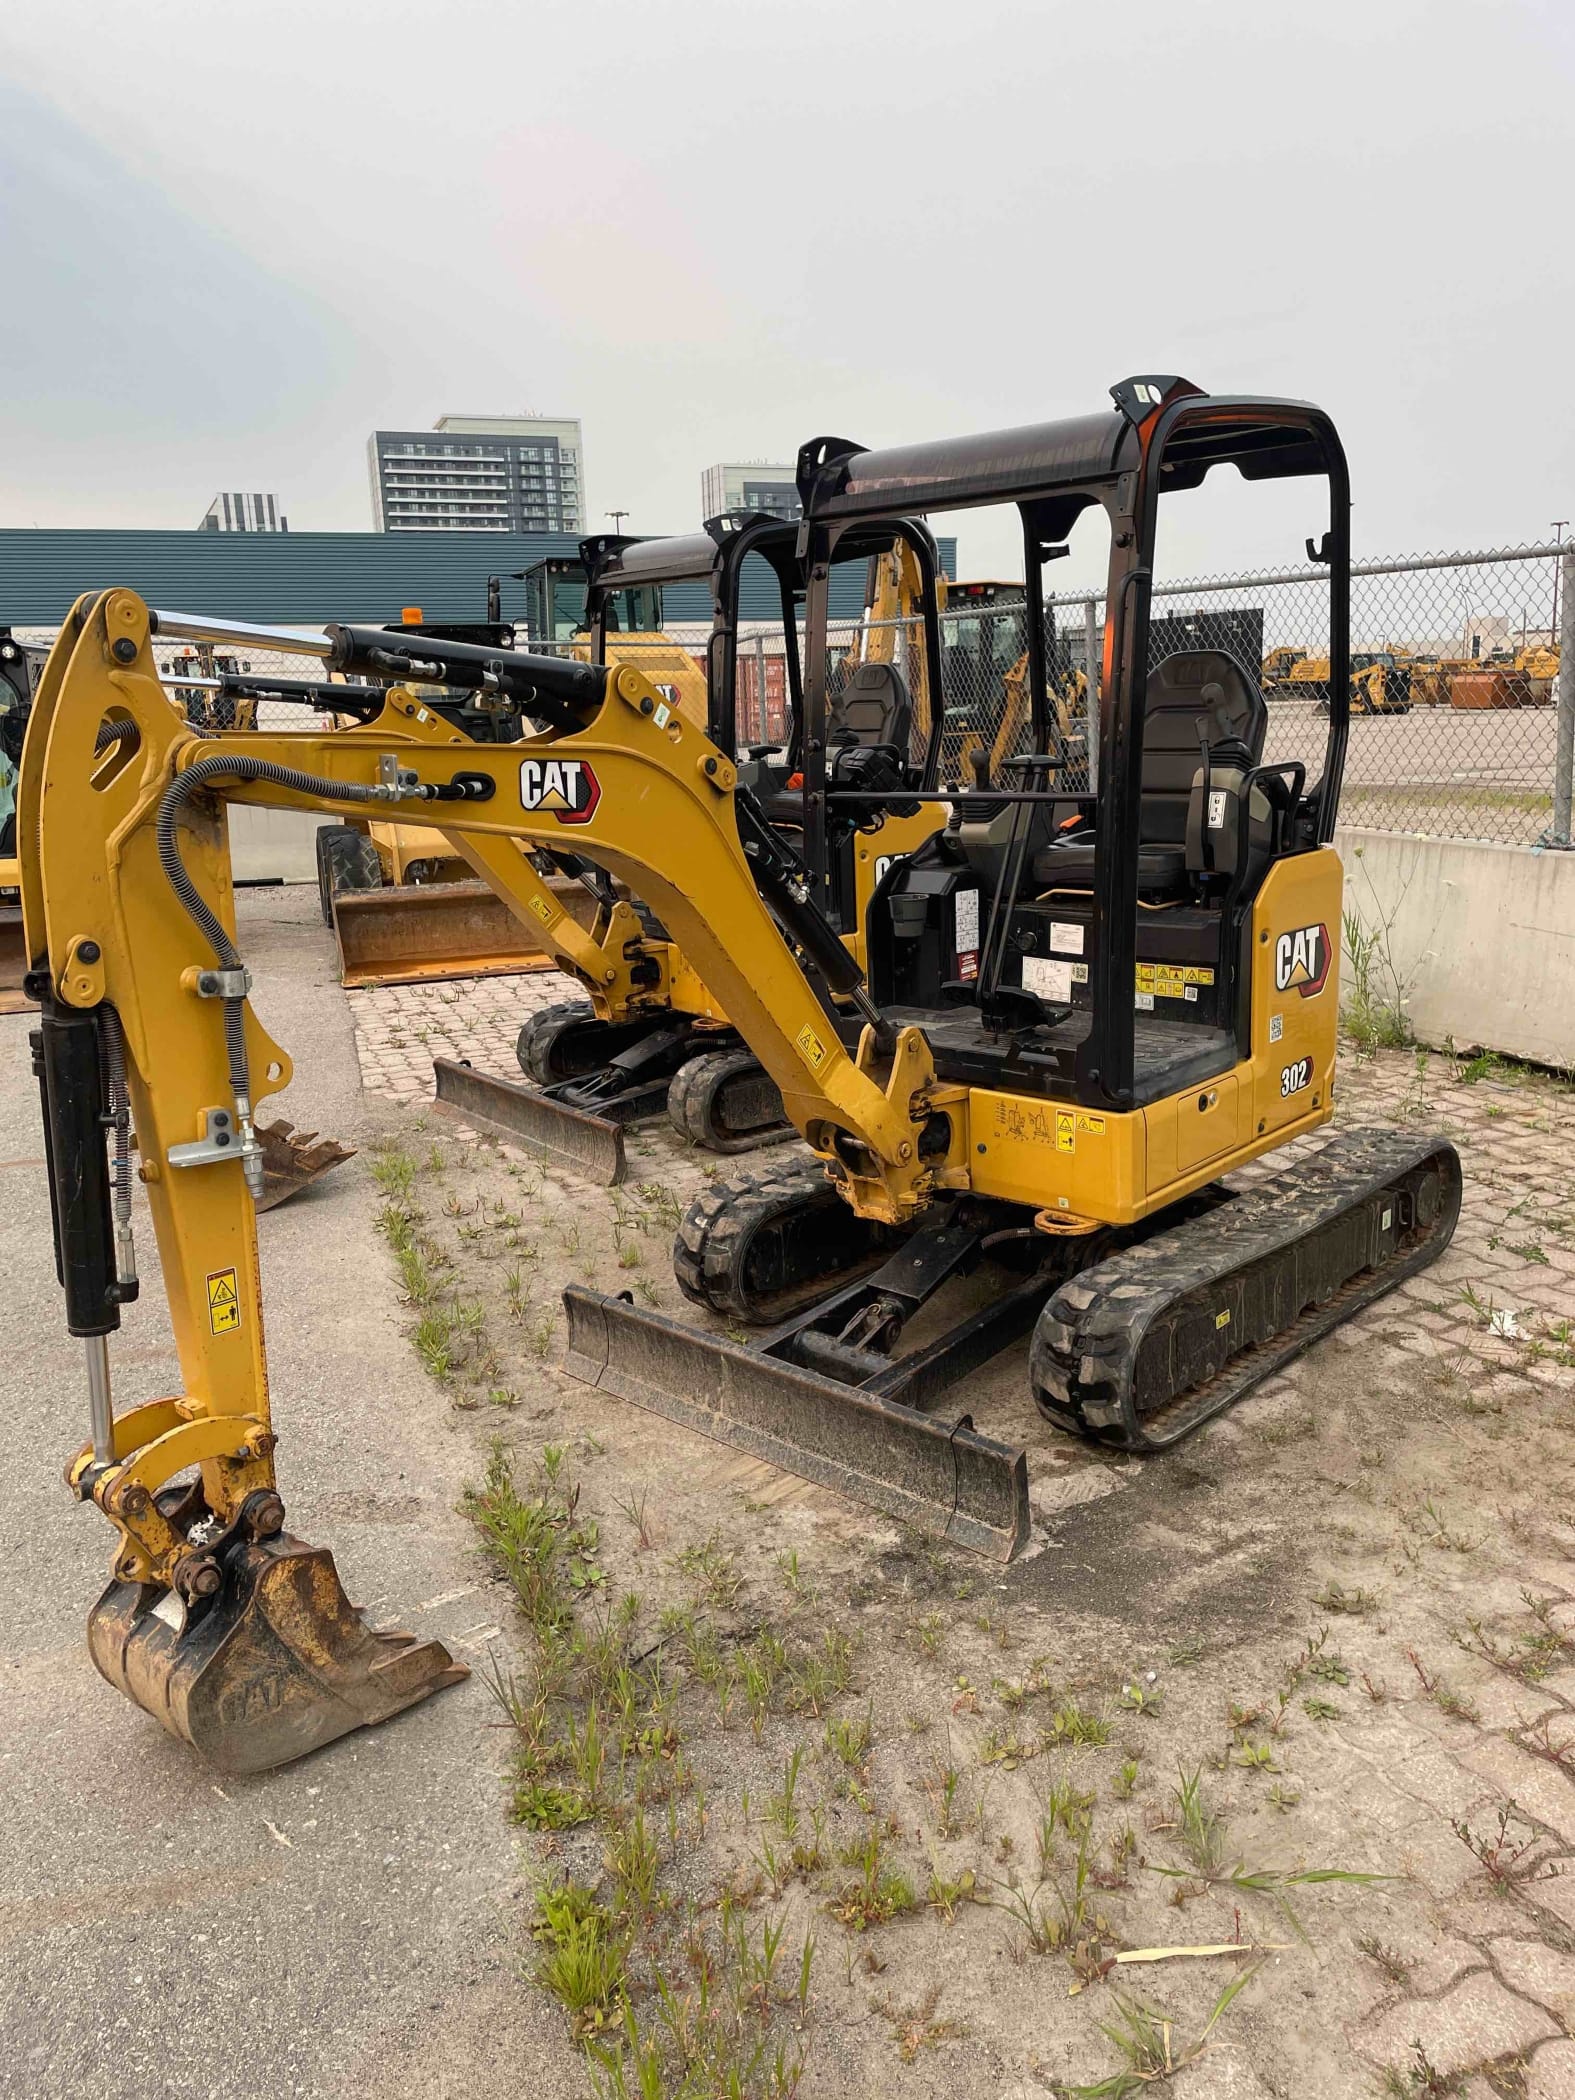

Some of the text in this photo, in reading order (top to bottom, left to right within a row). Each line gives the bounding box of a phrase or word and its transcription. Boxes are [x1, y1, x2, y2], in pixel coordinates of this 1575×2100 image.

[520, 760, 581, 809] CAT
[1276, 925, 1320, 990] CAT
[1281, 1059, 1307, 1096] 302
